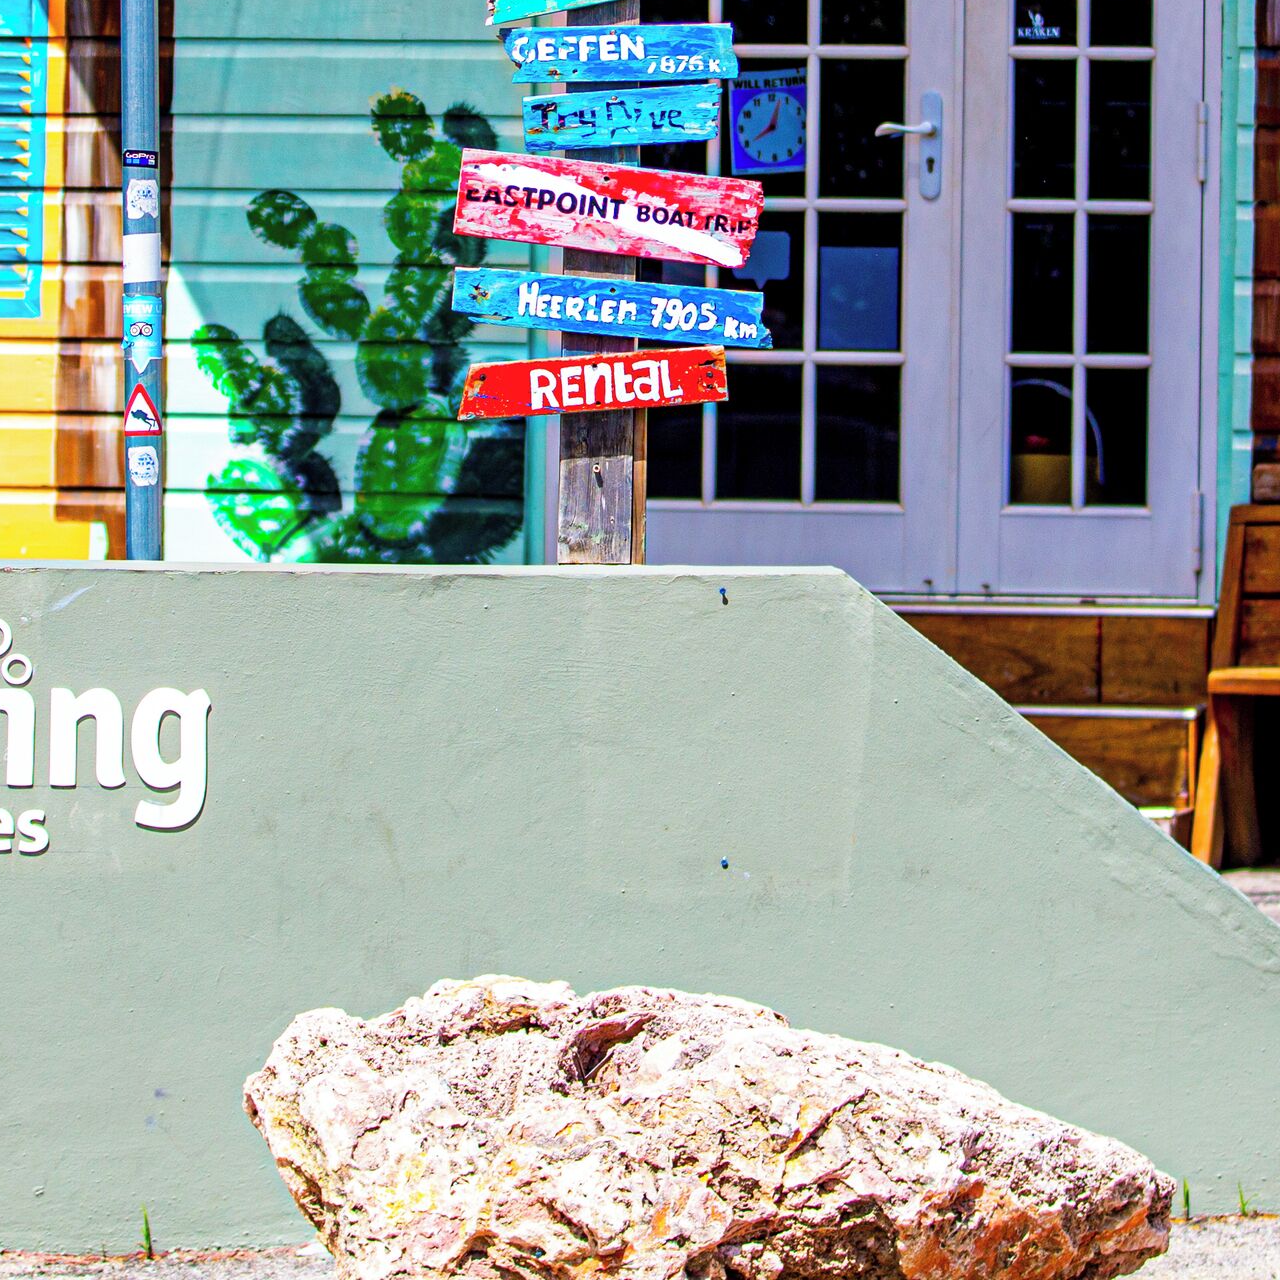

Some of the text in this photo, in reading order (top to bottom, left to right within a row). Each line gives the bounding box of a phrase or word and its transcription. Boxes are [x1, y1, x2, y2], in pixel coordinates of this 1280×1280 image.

[733, 80, 760, 89] WILL
[125, 152, 156, 160] GoPro
[465, 185, 625, 220] EASTPOINT
[637, 205, 696, 229] BOAT
[650, 296, 718, 332] 7905
